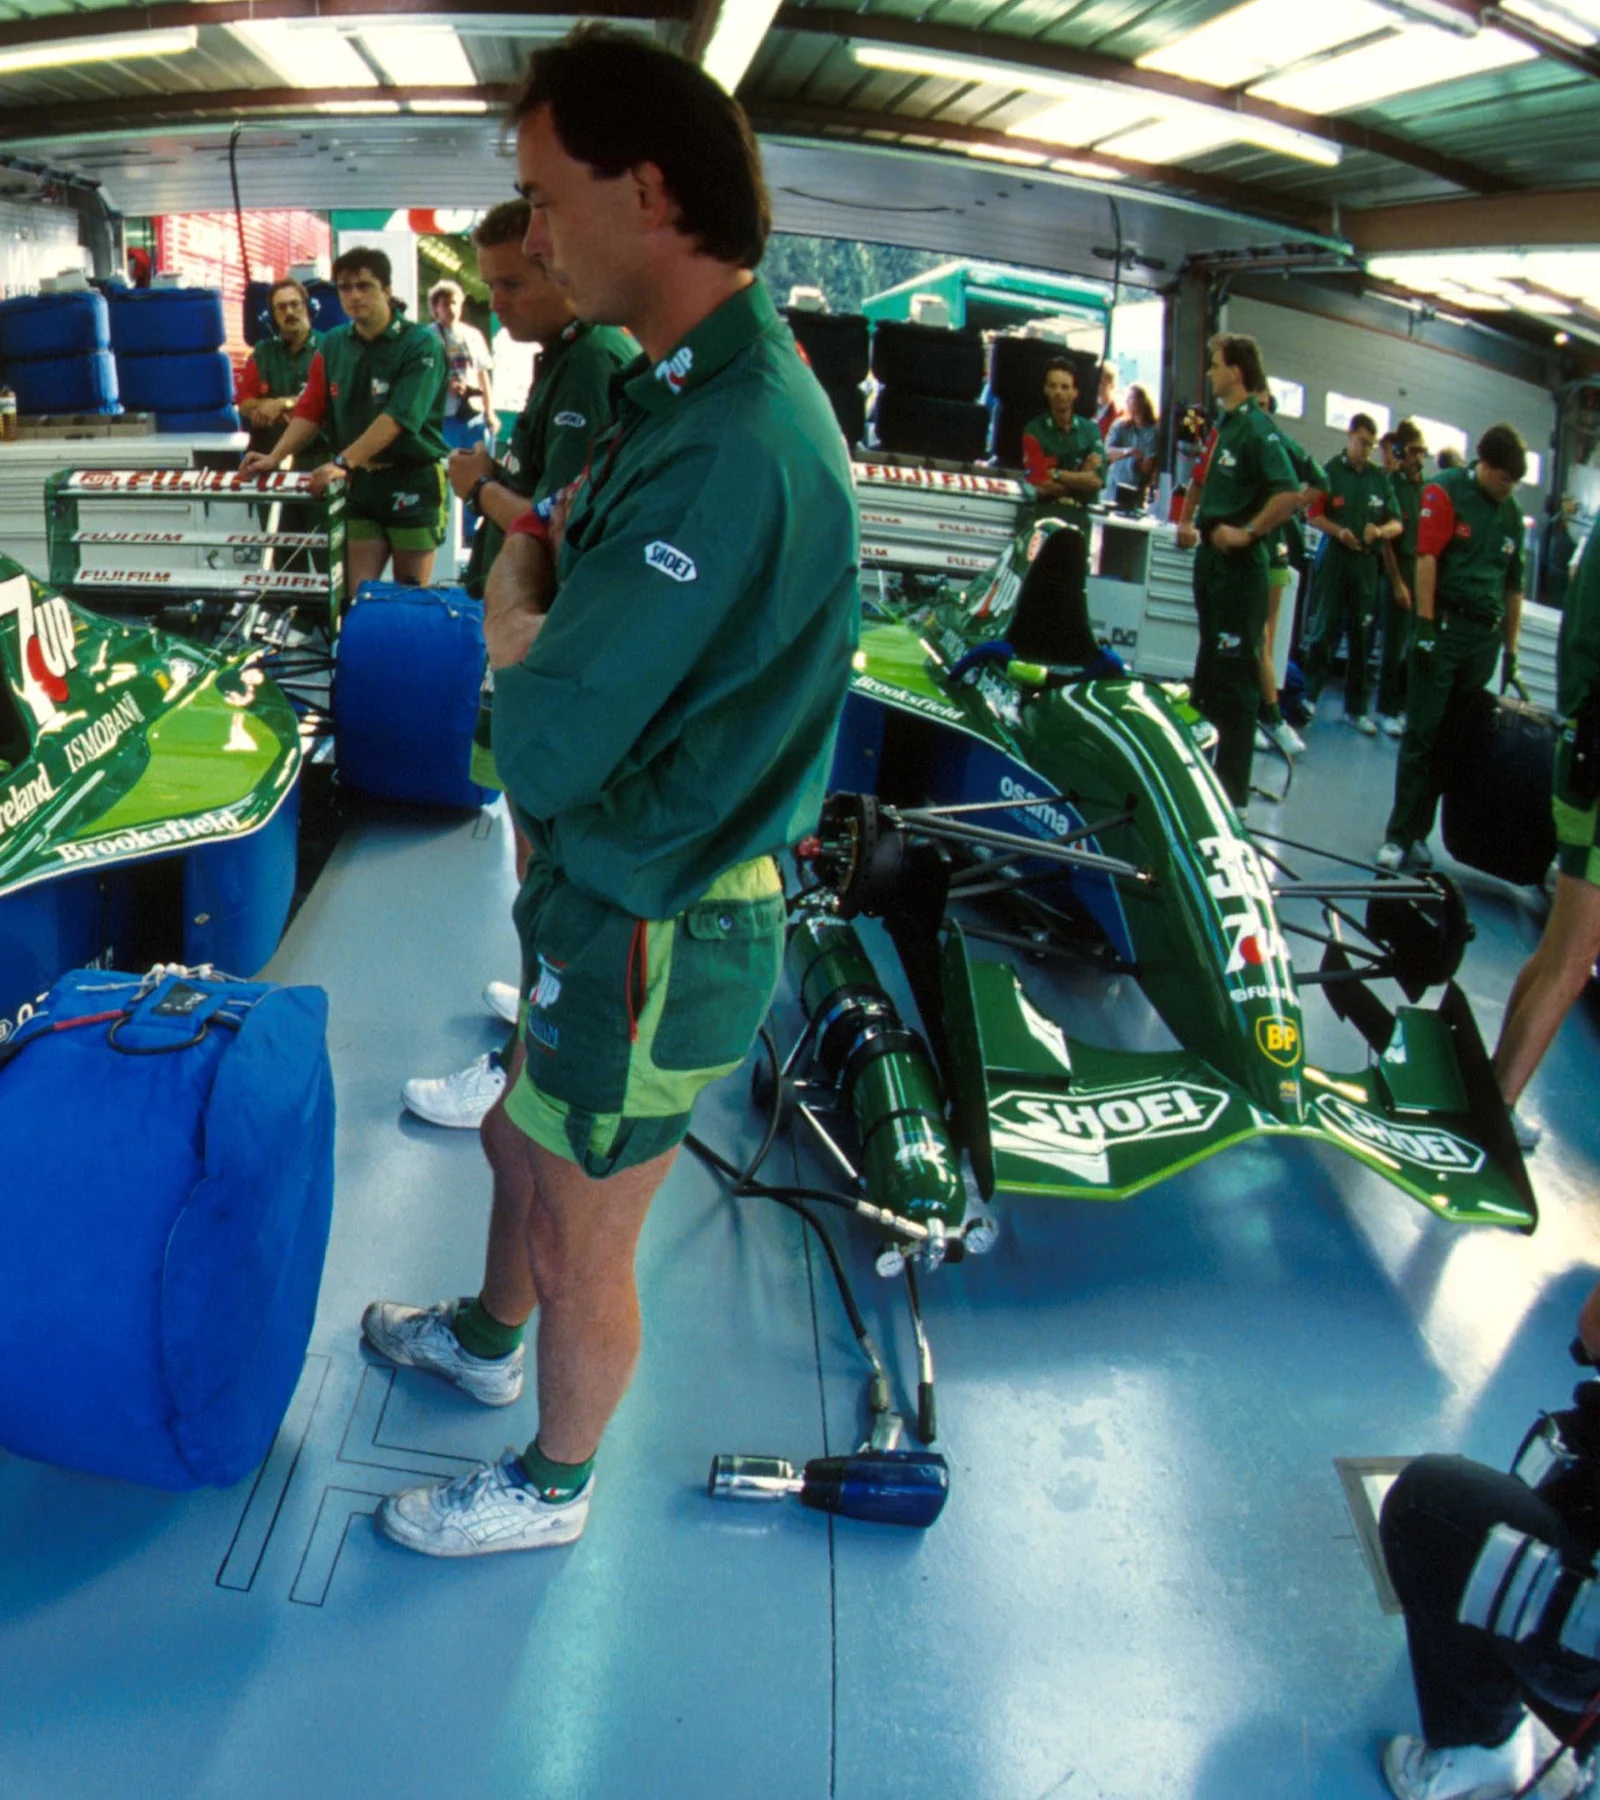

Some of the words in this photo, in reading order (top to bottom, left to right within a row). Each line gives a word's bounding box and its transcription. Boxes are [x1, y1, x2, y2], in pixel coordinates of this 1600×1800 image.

[655, 346, 694, 395] 7UP
[75, 531, 184, 543] FUJIFILM
[226, 535, 329, 548] FUJIFILM
[80, 569, 172, 583] FUJIFILM
[649, 543, 692, 580] SHOEI
[54, 810, 242, 864] Brooksfield
[1266, 1023, 1298, 1052] BP
[1014, 1088, 1206, 1135] SHOEI
[1346, 1106, 1472, 1164] SHOEI
